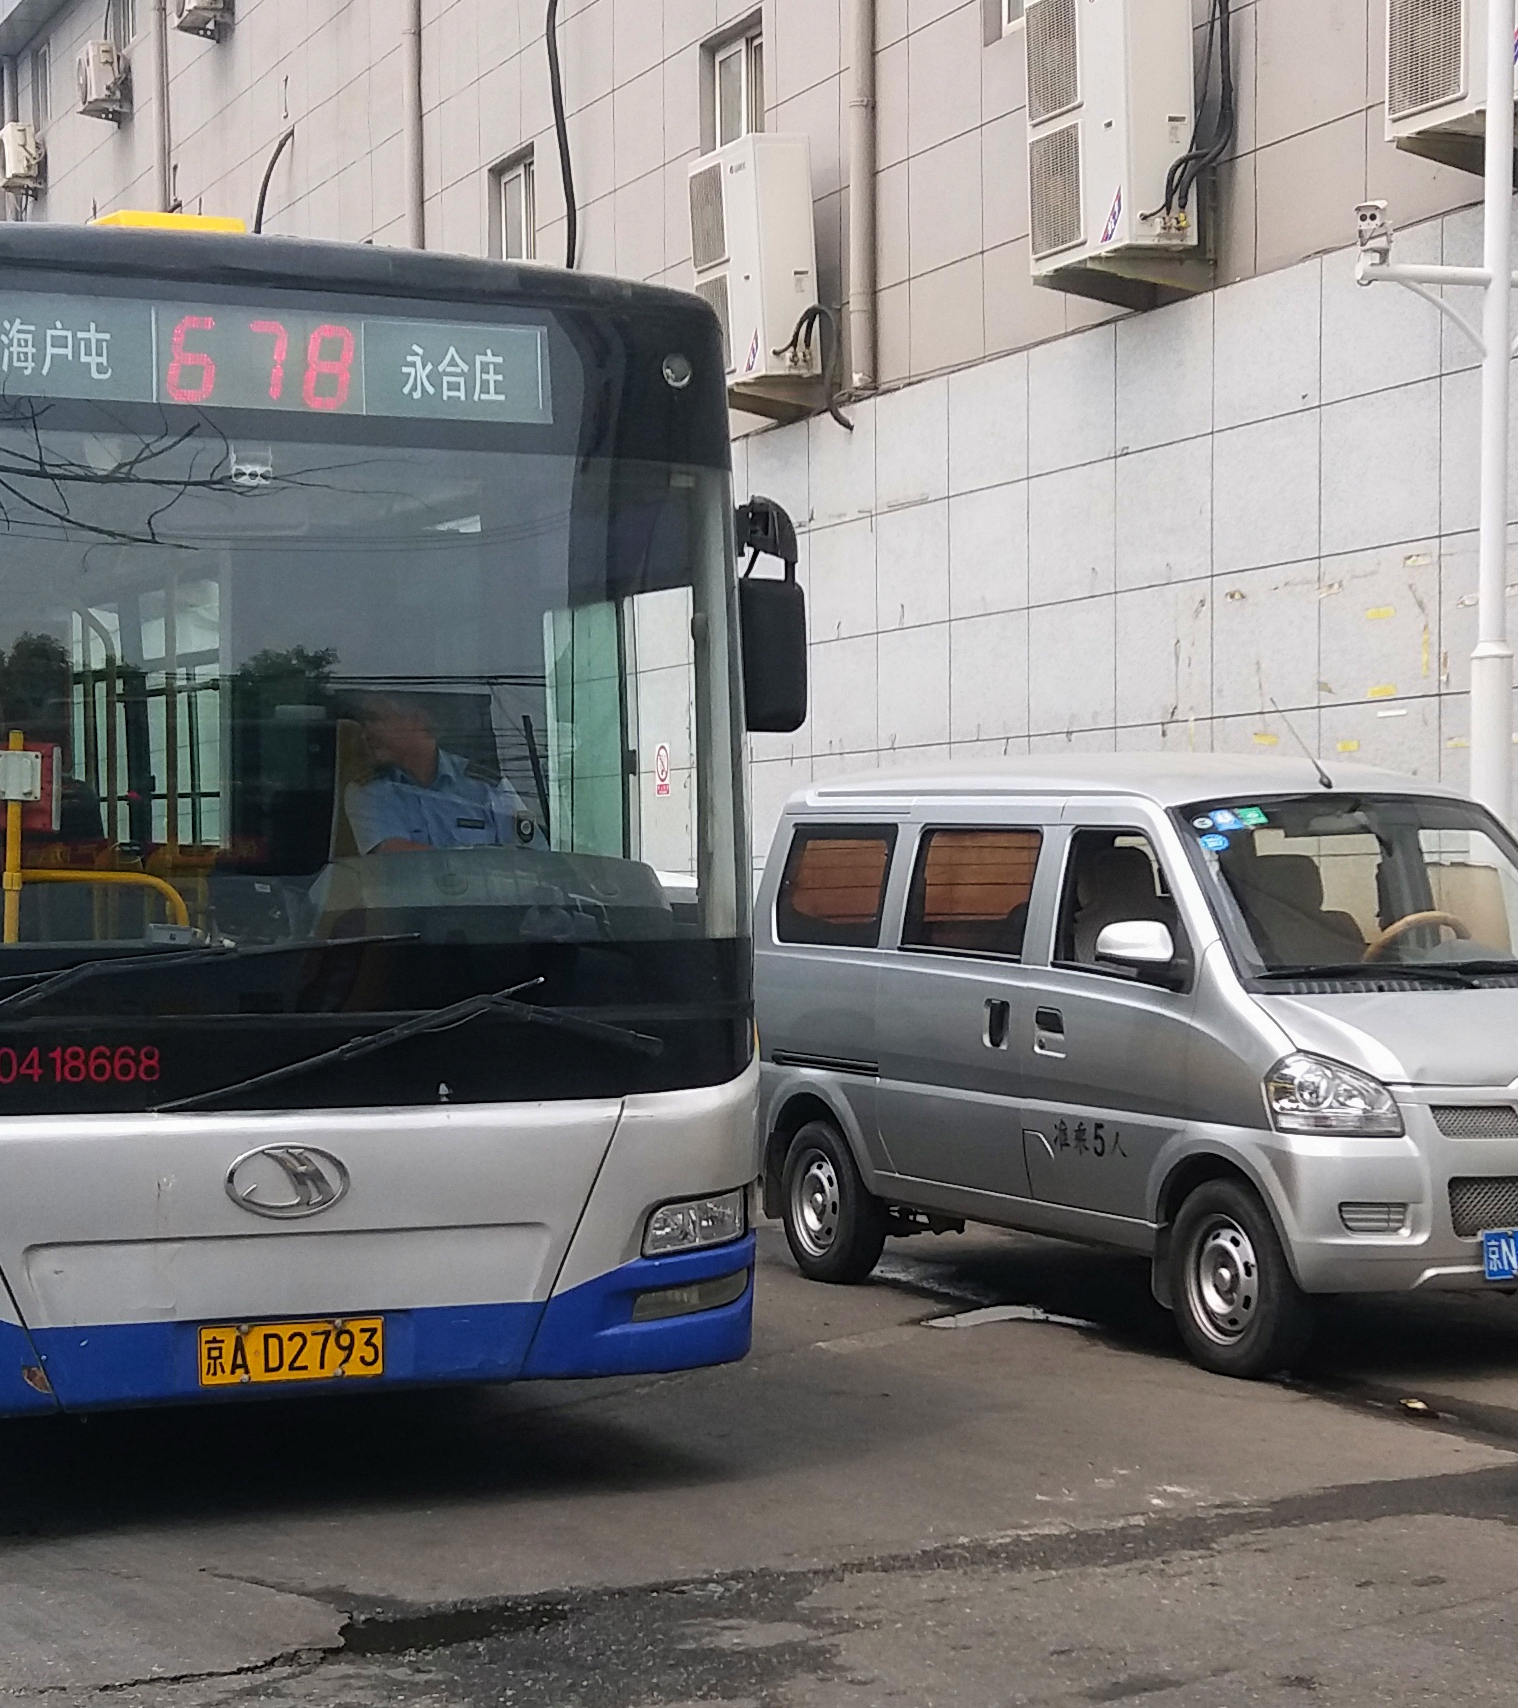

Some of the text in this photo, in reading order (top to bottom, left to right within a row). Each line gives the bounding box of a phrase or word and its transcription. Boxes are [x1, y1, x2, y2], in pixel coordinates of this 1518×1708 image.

[0, 318, 112, 380] 海户屯
[166, 315, 355, 411] 678
[401, 343, 506, 401] 永合庄
